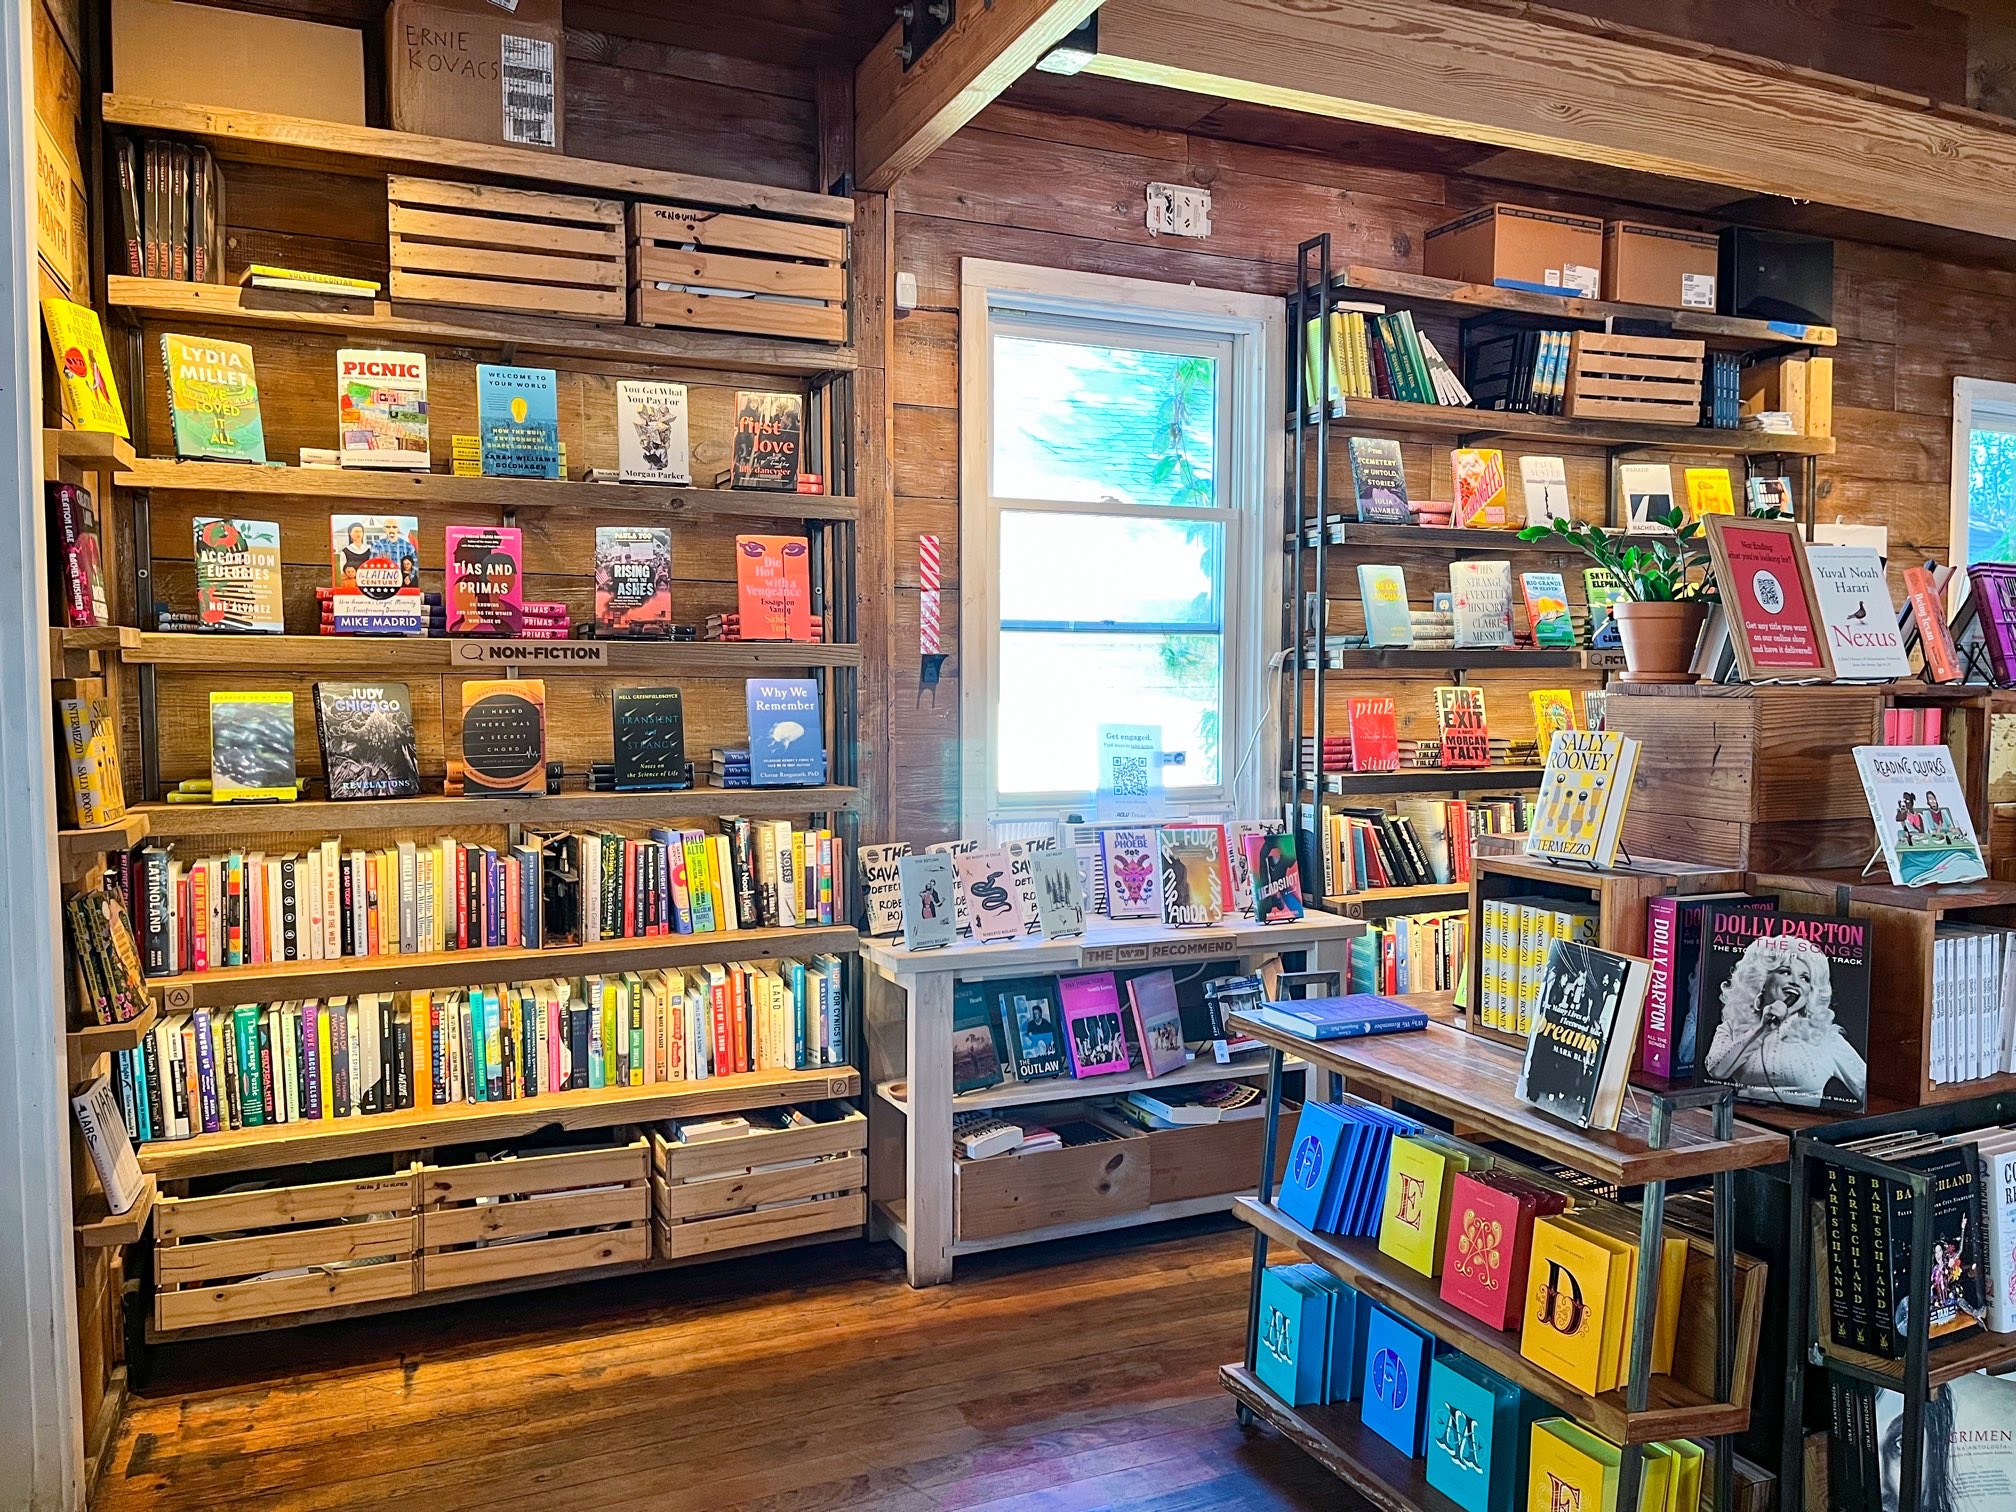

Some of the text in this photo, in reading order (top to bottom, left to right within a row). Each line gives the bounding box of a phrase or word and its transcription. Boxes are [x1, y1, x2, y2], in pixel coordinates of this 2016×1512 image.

[406, 26, 469, 52] ERNIE
[409, 49, 498, 80] KOVACS
[655, 210, 696, 222] PENGUIN
[182, 346, 242, 368] LYDIA
[179, 365, 248, 387] MILLET
[343, 362, 419, 378] PICNIC
[488, 372, 532, 380] WELCOME
[206, 388, 226, 400] WE
[624, 385, 682, 397] You Get What
[628, 395, 680, 406] You Pay For
[196, 402, 240, 416] LOVED
[214, 417, 225, 429] IT
[739, 416, 782, 436] first
[210, 432, 234, 445] ALL
[754, 439, 794, 454] love
[625, 470, 684, 480] Morgan Parker
[61, 490, 74, 543] CREATION LAKE
[1753, 542, 1773, 552] finding
[201, 551, 274, 566] ACCORDION
[764, 557, 782, 567] Die
[1760, 554, 1780, 564] looking
[1781, 555, 1791, 563] for?
[207, 564, 270, 580] EULOGIES
[453, 560, 513, 576] TÍAS AND
[614, 564, 650, 578] RISING
[1817, 567, 1878, 579] Yuval Noah
[460, 582, 508, 594] PRIMAS
[1467, 578, 1503, 587] STRANGE
[1835, 582, 1870, 593] Harari
[618, 583, 654, 596] ASHES
[745, 584, 801, 598] Vengeance
[1466, 591, 1506, 600] EVENTFUL
[1468, 602, 1504, 613] HISTORY
[341, 617, 417, 627] MIKE MADRID
[1915, 592, 1934, 641] Being Texan
[1473, 619, 1500, 628] CLAIRE
[1746, 621, 1756, 629] Get
[1472, 632, 1504, 641] MESSUD
[1832, 625, 1897, 648] Nexus
[489, 646, 599, 660] NON-FICTION
[1785, 646, 1812, 654] delivered!
[350, 688, 384, 700] JUDY
[760, 687, 807, 700] Why We
[1441, 690, 1482, 710] FIRE
[335, 700, 400, 713] CHICAGO
[756, 701, 814, 710] Remember
[1355, 699, 1393, 718] pink
[620, 715, 679, 724] TRANSIENT
[1444, 711, 1482, 728] EXIT
[1106, 733, 1152, 742] Get engaged.
[1445, 736, 1486, 745] MORGAN
[1559, 734, 1609, 751] SALLY
[627, 741, 675, 750] STRANGE
[1448, 747, 1488, 760] TALTY
[1360, 757, 1398, 770] slime
[1548, 752, 1613, 771] ROONEY
[1873, 757, 1946, 778] READING QUIRKS
[342, 779, 410, 790] REVELATIONS
[686, 835, 704, 845] PALO
[1115, 832, 1133, 841] IVAN
[687, 845, 704, 856] ALTO
[1114, 840, 1148, 848] PHOEBE
[783, 850, 792, 882] NOISE
[402, 855, 412, 902] ANGELA DAVIS
[148, 861, 161, 933] LATINOLAND
[1714, 913, 1863, 945] DOLLY PARTON
[1653, 918, 1669, 967] DOLLY
[1713, 935, 1863, 958] ALL THE SONGS
[1087, 951, 1113, 962] THE
[1152, 942, 1233, 957] RECOMMEND
[772, 985, 781, 1010] LAND
[1650, 969, 1668, 1032] PARTON
[1535, 1016, 1600, 1053] Dreams
[1648, 1040, 1666, 1049] SONGS
[248, 1019, 259, 1096] The Language Puzzle
[1553, 1045, 1595, 1066] MARK BLAKE
[1020, 1061, 1059, 1076] OUTLAW
[836, 1081, 843, 1093] Z
[79, 1103, 98, 1152] LIARS
[1828, 1170, 1844, 1298] BARTSCHLAND
[1848, 1175, 1863, 1304] BARTSCHLAND
[1871, 1179, 1886, 1309] BARTSCHLAND
[1938, 1307, 1949, 1318] TAXI
[1950, 1431, 2012, 1443] CRIMEN
